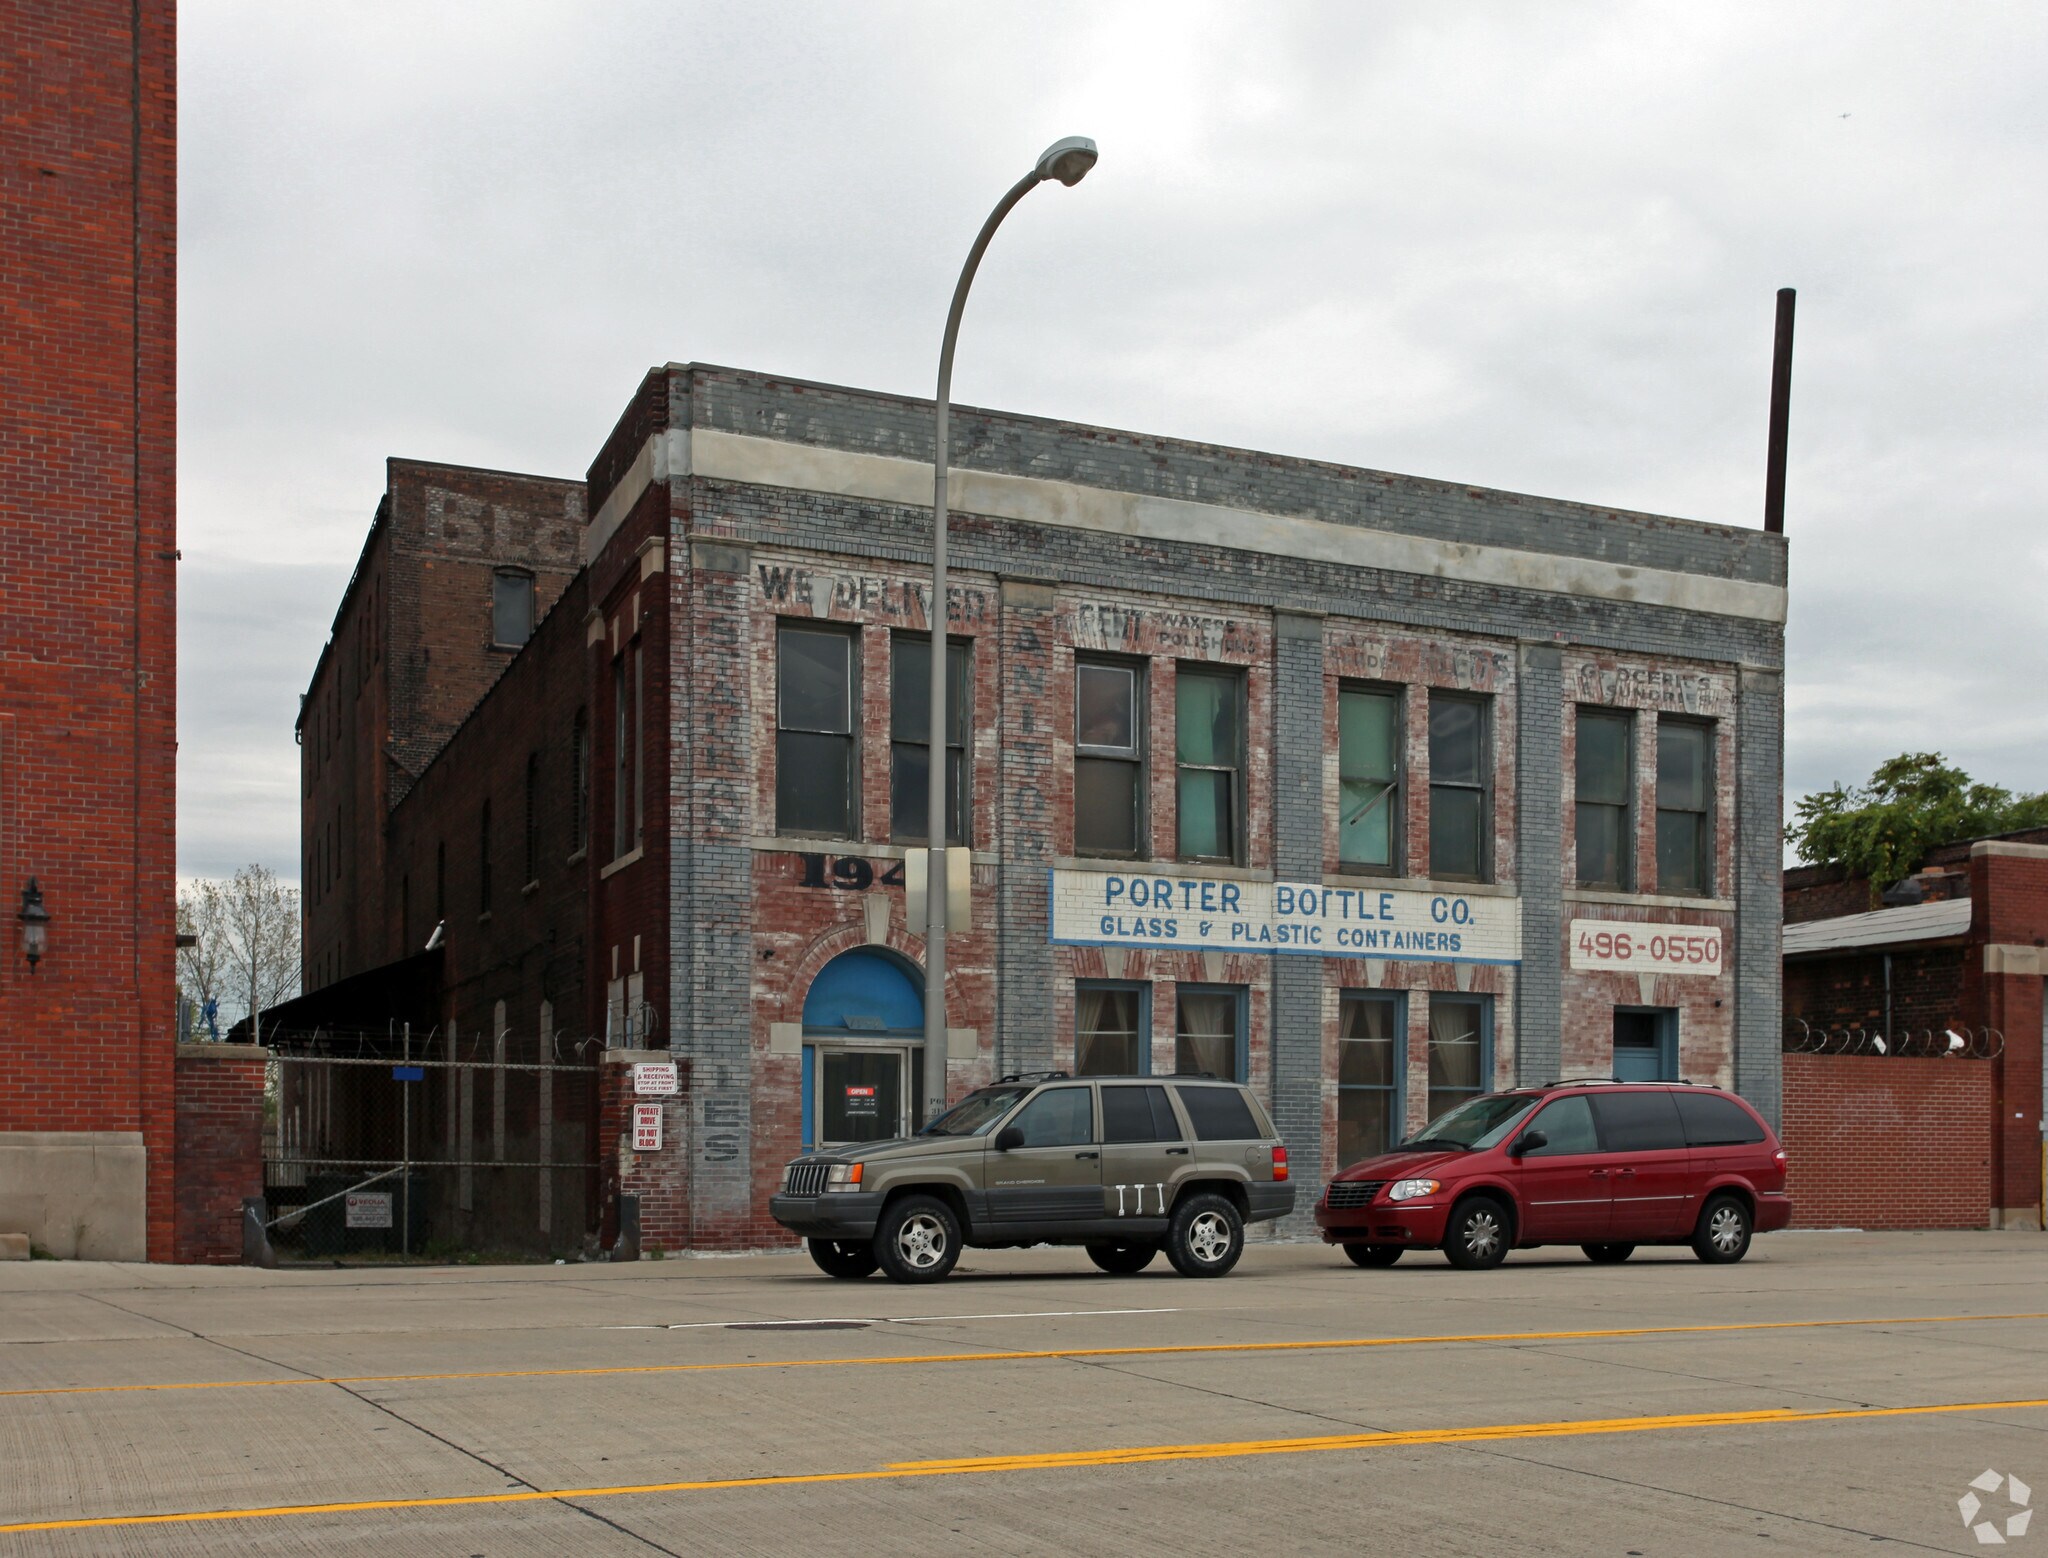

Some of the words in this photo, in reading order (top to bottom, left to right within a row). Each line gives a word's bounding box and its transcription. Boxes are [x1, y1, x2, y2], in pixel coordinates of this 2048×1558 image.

[758, 564, 813, 603] WE
[1580, 663, 1711, 691] GOCERIES
[1105, 876, 1241, 914] PORTER
[1276, 886, 1395, 921] BOTTLE
[1431, 896, 1475, 925] CO.
[1100, 915, 1178, 938] GLASS
[1199, 920, 1213, 937] &
[1231, 922, 1323, 945] PLASTIC
[1337, 927, 1462, 951] CONTAINERS
[1578, 931, 1721, 964] 496-0550
[851, 1088, 868, 1096] OPEN
[637, 1107, 659, 1116] PRIVATE
[640, 1117, 656, 1125] DRIVE
[638, 1129, 646, 1137] DO
[646, 1129, 657, 1137] NOT
[639, 1139, 656, 1147] BLOCK
